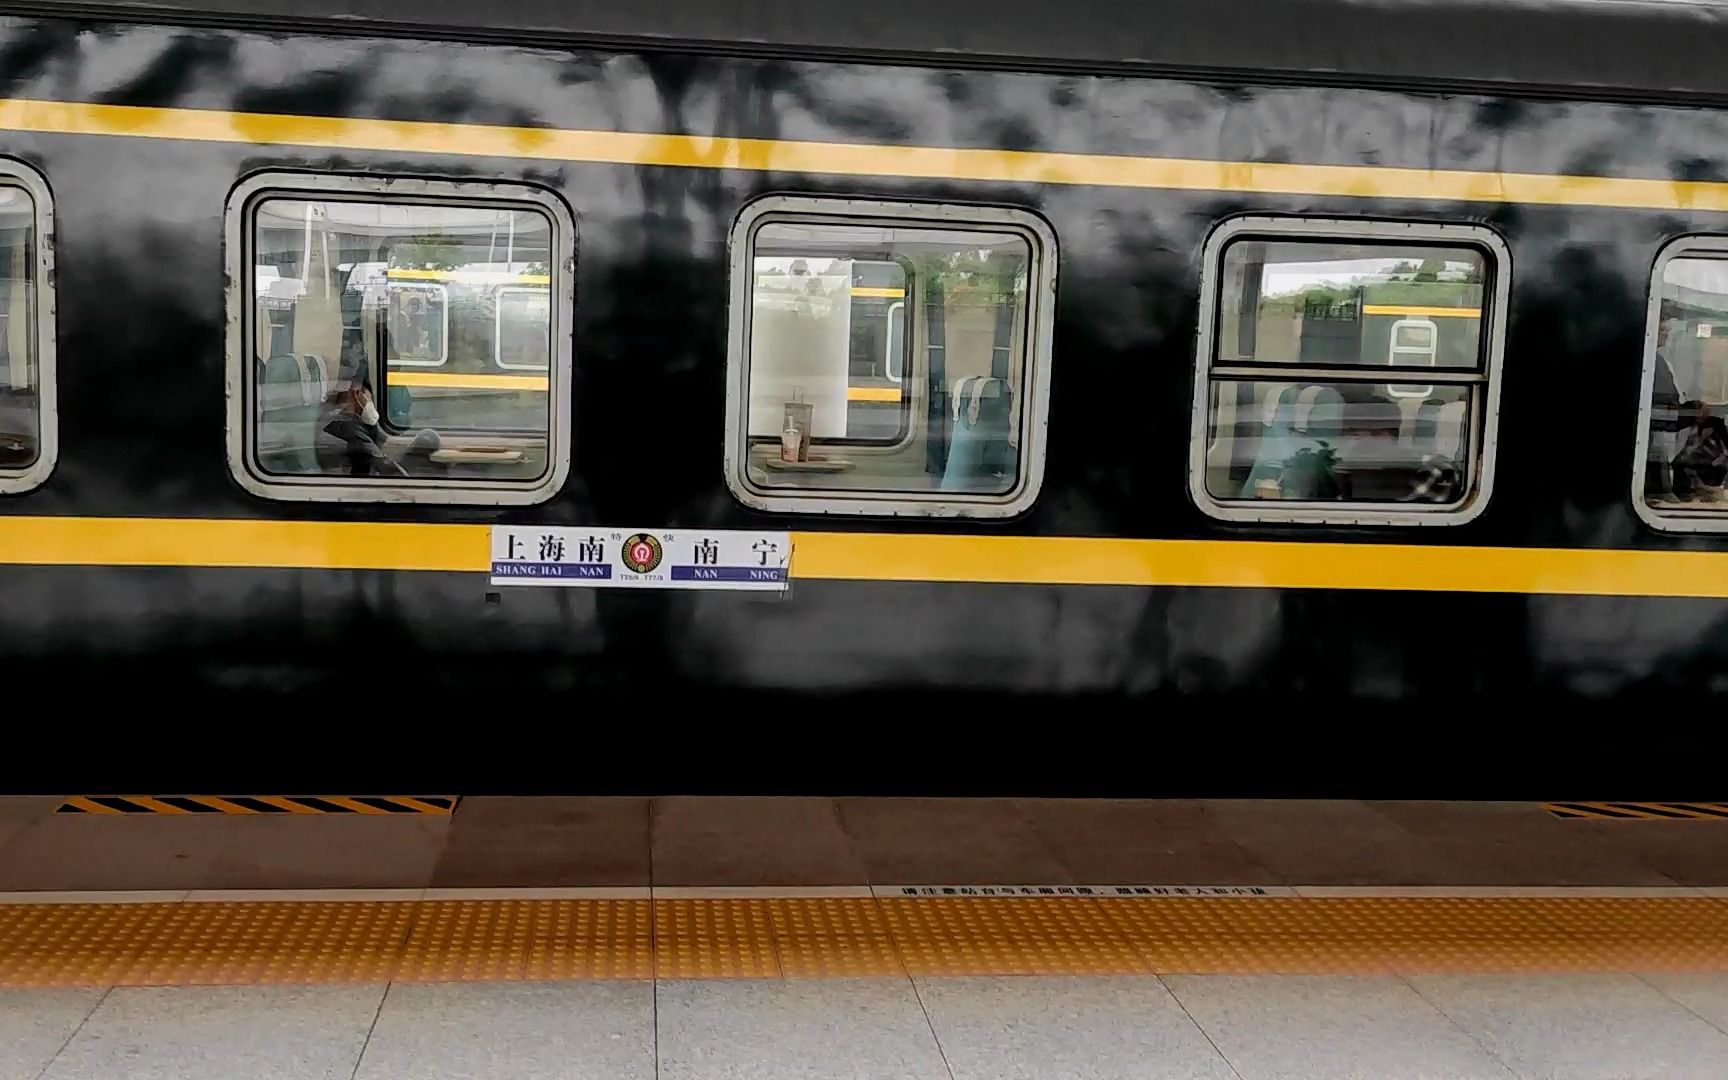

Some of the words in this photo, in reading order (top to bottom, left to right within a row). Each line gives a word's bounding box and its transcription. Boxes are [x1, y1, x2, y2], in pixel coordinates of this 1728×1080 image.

[498, 534, 605, 562] 上海南
[694, 538, 777, 566] 南宁
[496, 565, 536, 575] SHANG
[541, 566, 562, 576] HAI
[580, 567, 604, 577] NAN
[695, 568, 718, 579] NAN
[750, 570, 779, 580] NING
